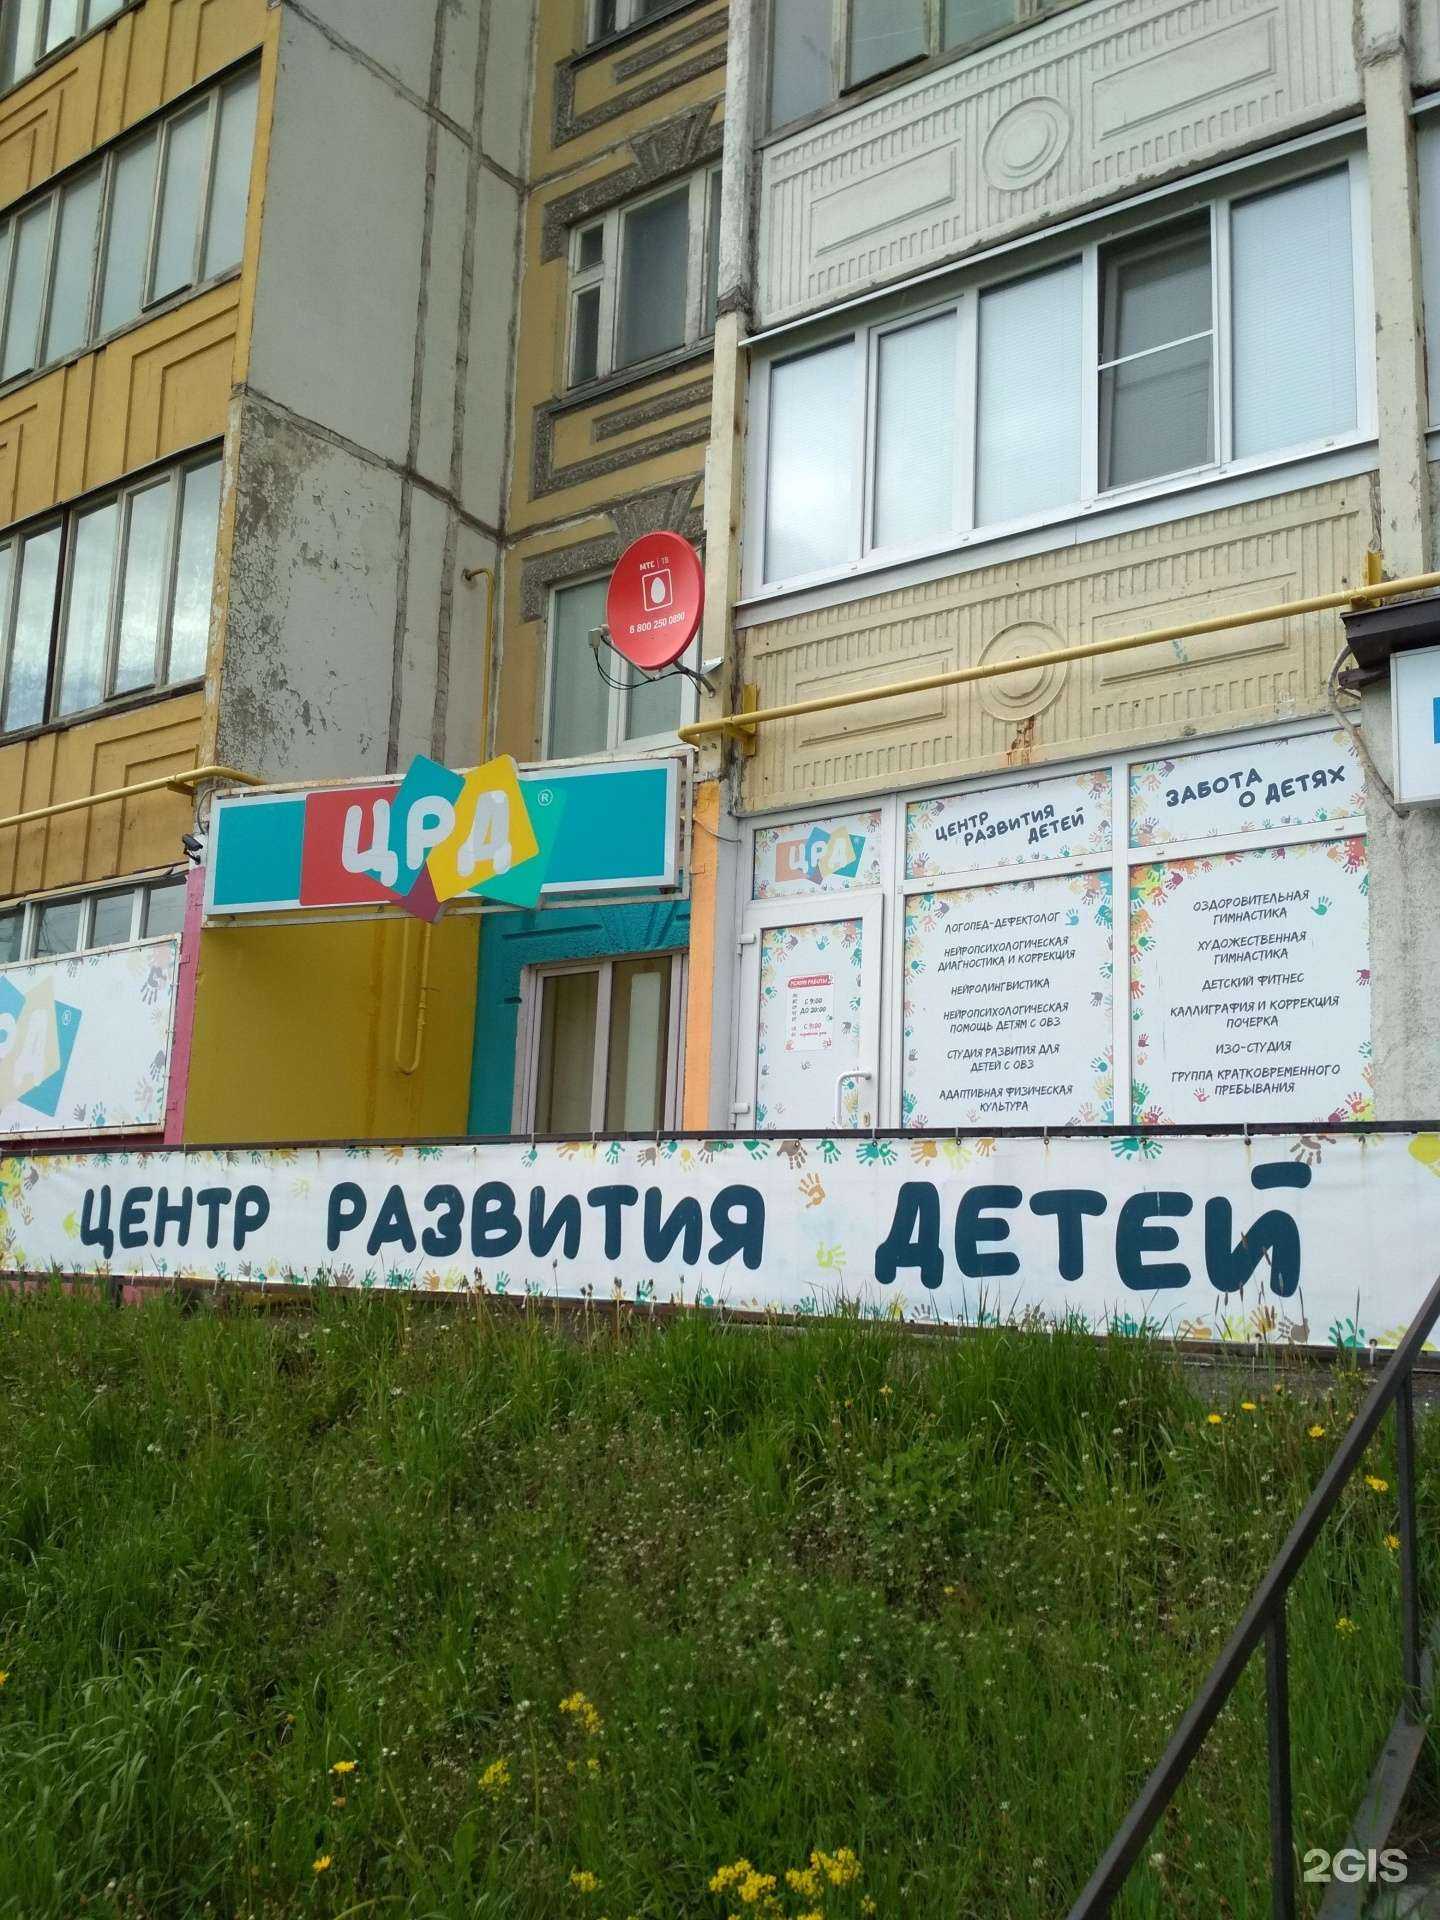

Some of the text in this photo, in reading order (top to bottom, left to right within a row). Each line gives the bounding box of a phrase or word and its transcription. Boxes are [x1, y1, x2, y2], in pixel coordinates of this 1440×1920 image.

[636, 621, 652, 633] 800
[653, 617, 668, 630] 250
[1165, 767, 1263, 808] ЗАБОТА
[1238, 765, 1346, 808] О ДЕТЯХ
[935, 811, 989, 842] ЦЕНТР
[963, 804, 1055, 846] РАЗВИТИЯ
[1027, 806, 1085, 845] ДЕТЕЙ
[341, 789, 513, 888] ЦРД
[788, 836, 851, 876] ЦРД
[1192, 889, 1310, 912] ОЗДОРОВИТЕЛЬНАЯ
[944, 911, 1061, 935] ЛОГОПЕД-ДЕФЕКТОЛОГ
[1213, 907, 1287, 926] ГИМНАСТИКА
[944, 935, 1069, 958] НЕЙРОПСИХОЛОГИЧЕСКАЯ
[1197, 930, 1307, 952] ХУДОЖЕСТВЕННАЯ
[937, 949, 1076, 973] ДИАГНОСТИКА И КОРРЕКЦИЯ
[1214, 948, 1289, 965] ГИМНАСТИКА
[951, 977, 1050, 996] НЕЙРОЛИНГВИСТИКА
[1201, 972, 1305, 992] ДЕТСКИЙ ФИТНЕС
[943, 1001, 1069, 1021] НЕЙРОПСИХОЛОГИЧЕСКАЯ
[1170, 996, 1340, 1017] КАЛЛИГРАФИЯ И КОРРЕКЦИЯ
[949, 1016, 1061, 1034] ПОМОЩЬ ДЕТЯМ С ОВЗ
[1226, 1015, 1279, 1029] ПОЧЕРКА
[947, 1043, 1060, 1060] СТУДИЯ РАЗВИТИЯ ДЛЯ
[1215, 1040, 1292, 1055] ИЗО-СТУДИЯ
[970, 1059, 1035, 1073] ДЕТЕЙ С ОВЗ
[1171, 1064, 1341, 1083] ГРУППА КРАТКОВРЕМЕННОГО
[939, 1084, 1073, 1100] АДАПТИВНАЯ ФИЗИЧЕСКАЯ
[1214, 1082, 1295, 1096] ПРЕБЫВАНИЯ
[979, 1100, 1029, 1113] КУЛЬТУРА
[80, 1161, 1312, 1298] ЦЕНТР РАЗВИТИЯ ДЕТЕЙ
